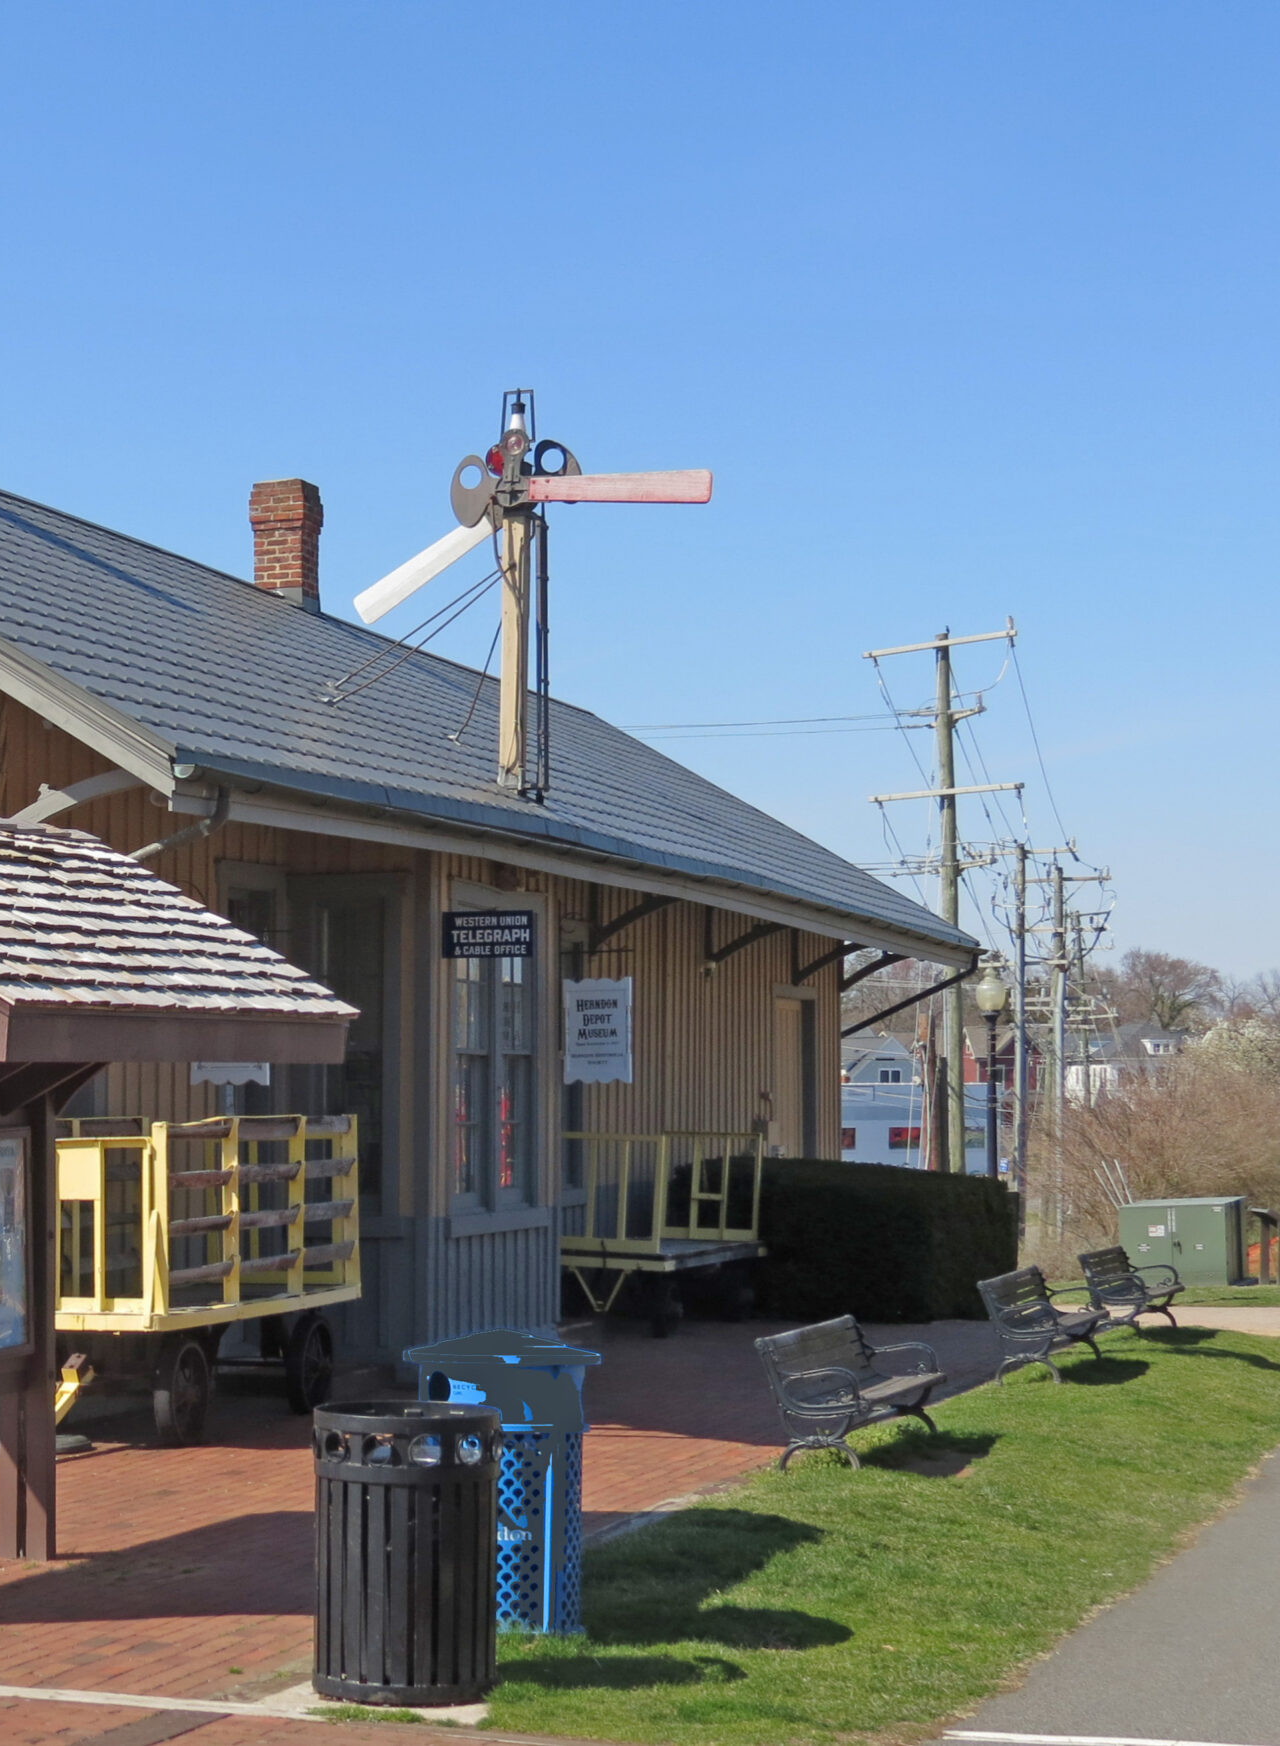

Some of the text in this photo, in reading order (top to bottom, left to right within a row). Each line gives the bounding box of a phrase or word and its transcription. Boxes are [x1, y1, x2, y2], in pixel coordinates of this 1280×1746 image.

[454, 915, 528, 928] WESTERN UNION
[451, 928, 530, 943] TELEGRAPH
[454, 944, 527, 956] & CABLE OFFICE
[576, 999, 618, 1012] HERNDON
[582, 1014, 612, 1027] DEPOT
[577, 1028, 618, 1041] MUSEUM
